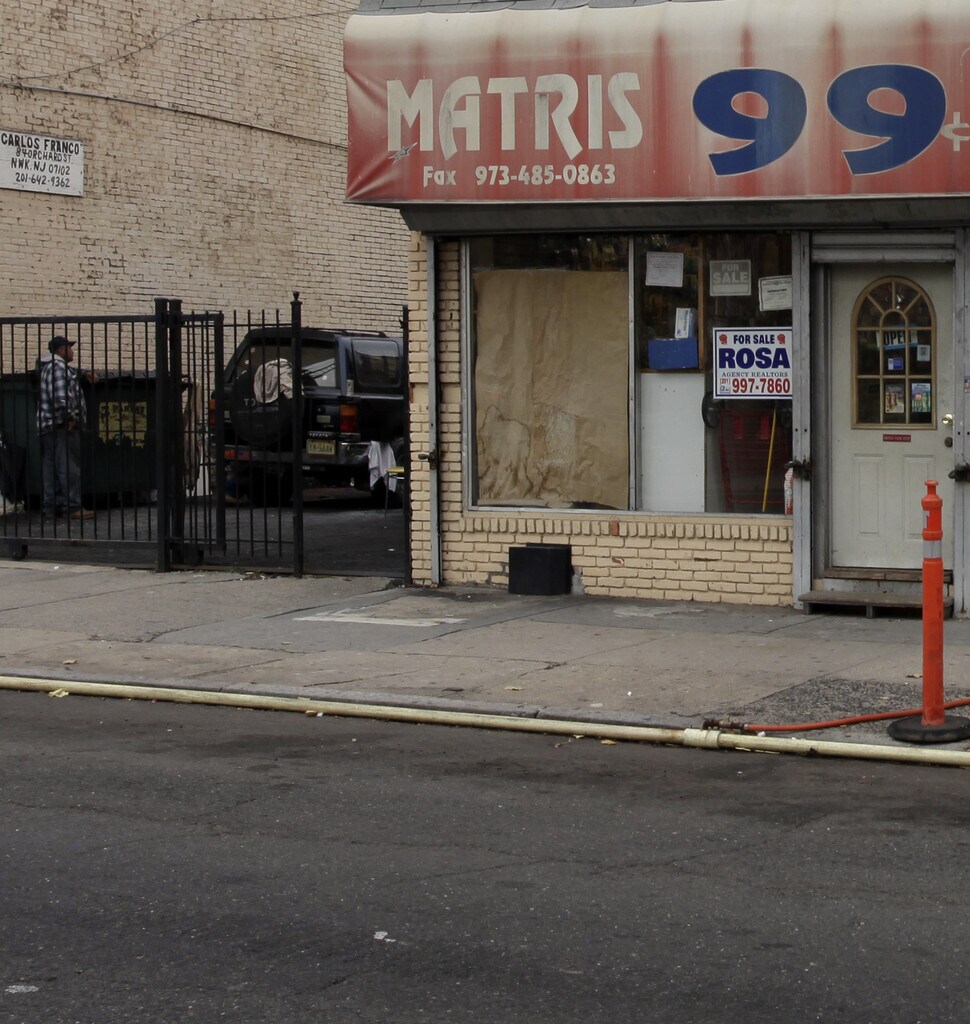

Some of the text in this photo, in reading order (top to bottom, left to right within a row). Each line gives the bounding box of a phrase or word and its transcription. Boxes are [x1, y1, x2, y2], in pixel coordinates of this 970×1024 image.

[386, 72, 644, 160] MATRIS
[1, 133, 80, 155] CARLOS FRANCO
[33, 161, 46, 173] NJ
[423, 165, 616, 187] Fax 973-485-0863
[722, 263, 739, 272] FOR
[713, 272, 748, 284] SALE
[733, 334, 775, 344] FOR SALE
[718, 347, 791, 369] ROSA
[732, 378, 791, 393] 997-7860
